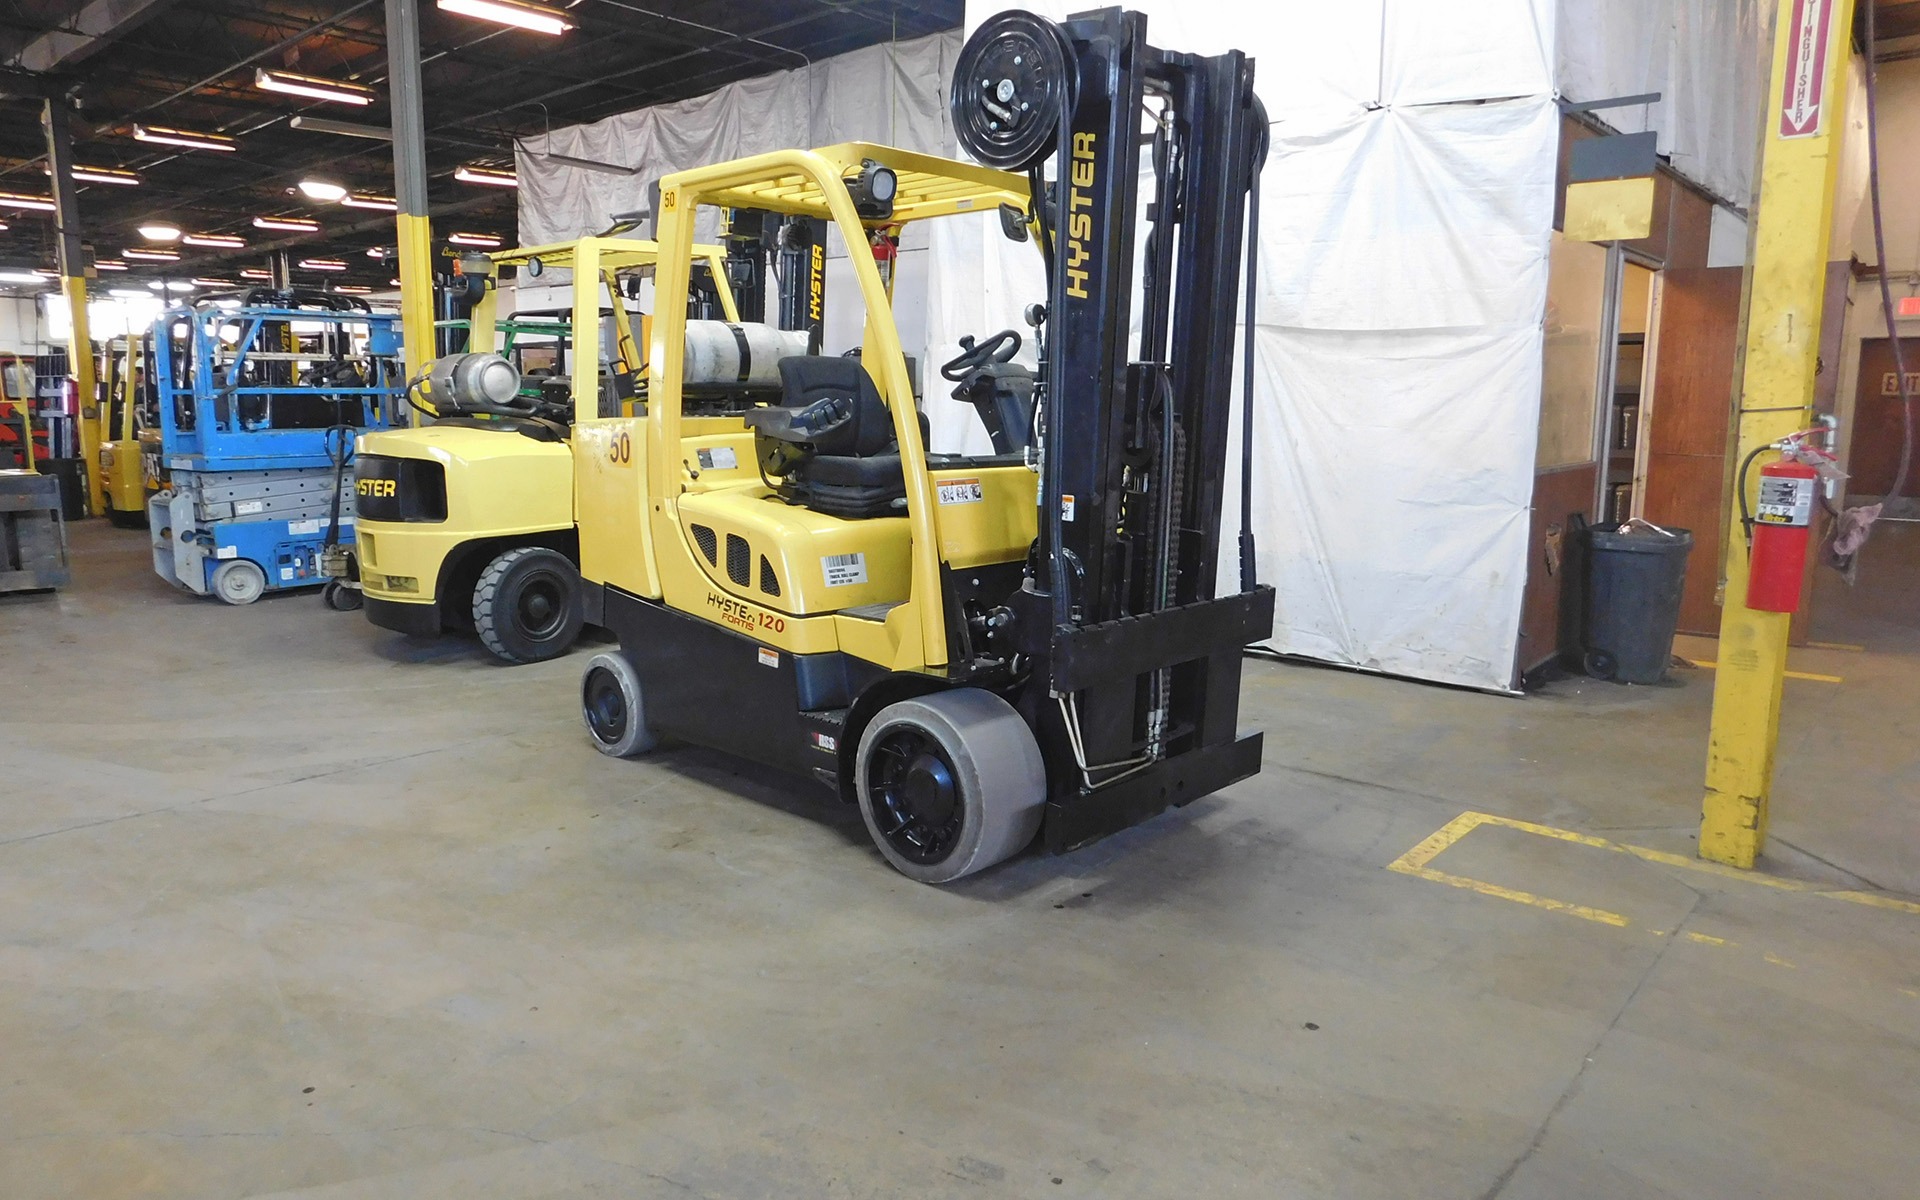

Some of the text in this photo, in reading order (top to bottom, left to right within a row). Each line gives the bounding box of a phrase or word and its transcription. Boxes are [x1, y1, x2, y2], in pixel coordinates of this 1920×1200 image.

[1795, 0, 1816, 123] TINGUISHER
[664, 191, 674, 207] 50
[1067, 132, 1096, 299] HYSTER
[810, 244, 823, 320] HYSTER
[610, 432, 630, 463] 50
[721, 612, 755, 632] FORTIS
[758, 612, 785, 633] 120
